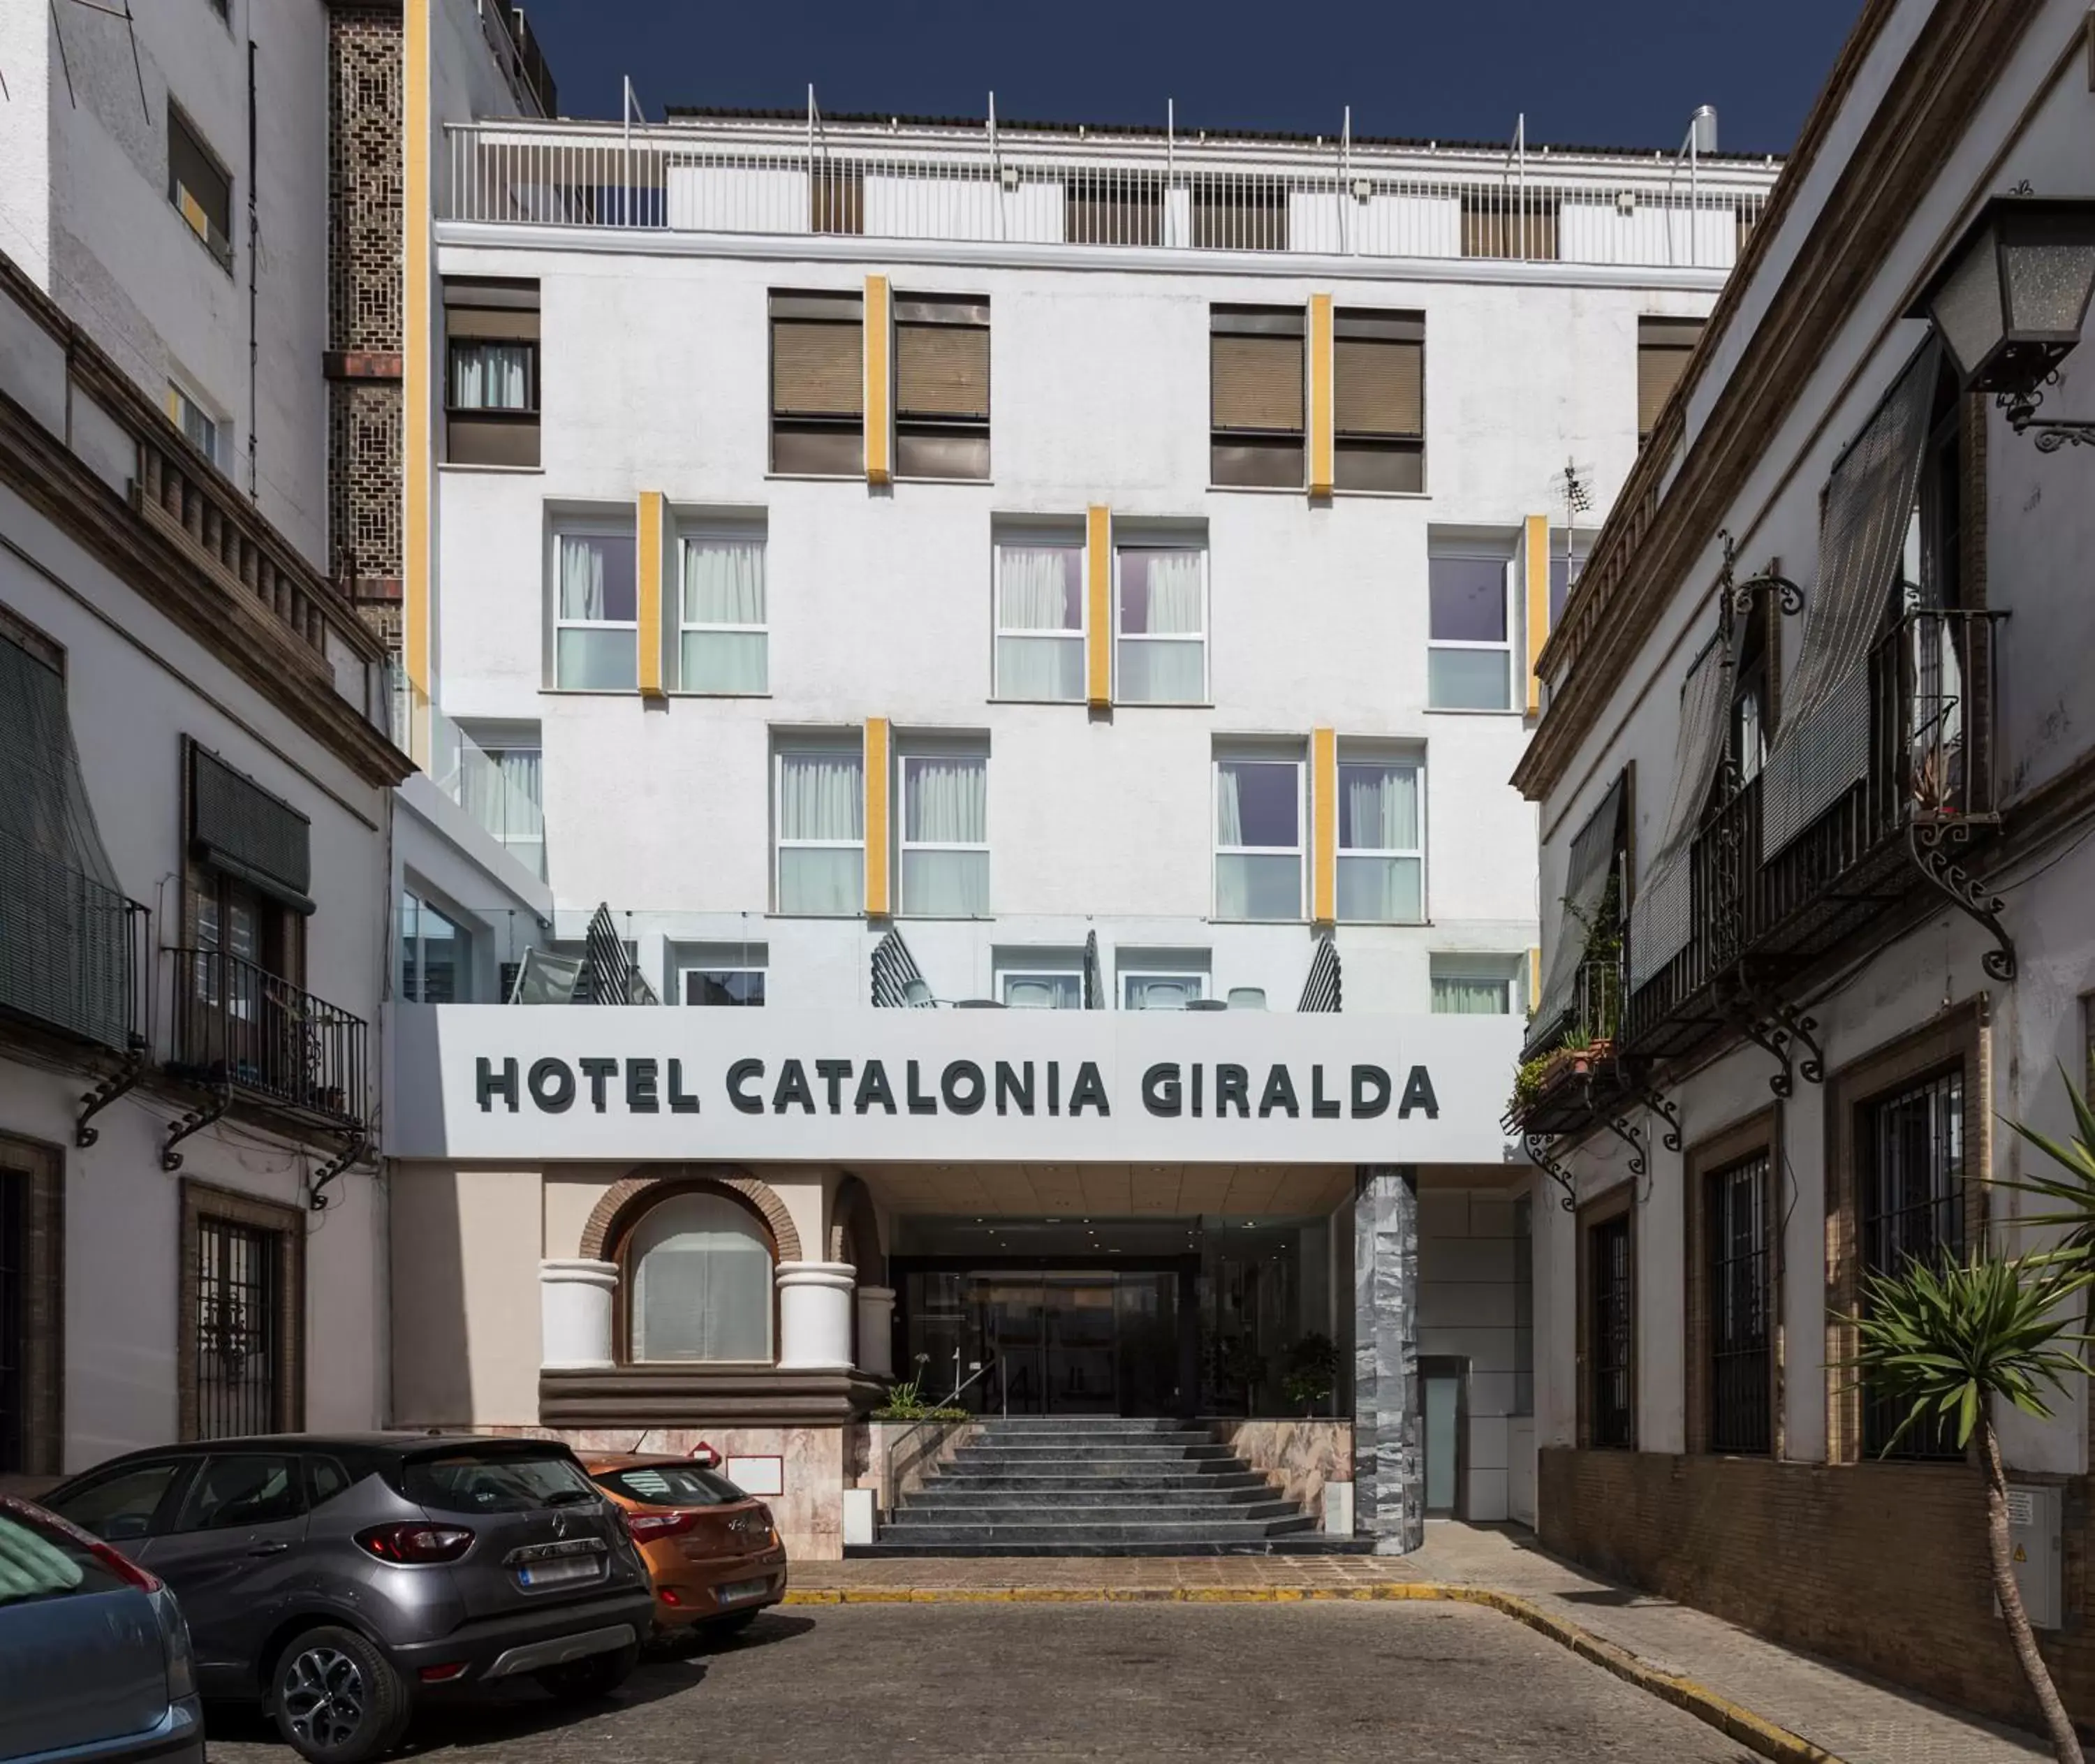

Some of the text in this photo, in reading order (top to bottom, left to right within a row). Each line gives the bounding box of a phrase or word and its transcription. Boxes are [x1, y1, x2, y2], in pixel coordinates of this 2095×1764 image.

[476, 1057, 1439, 1119] HOTEL CATALONIA GIRALDA
